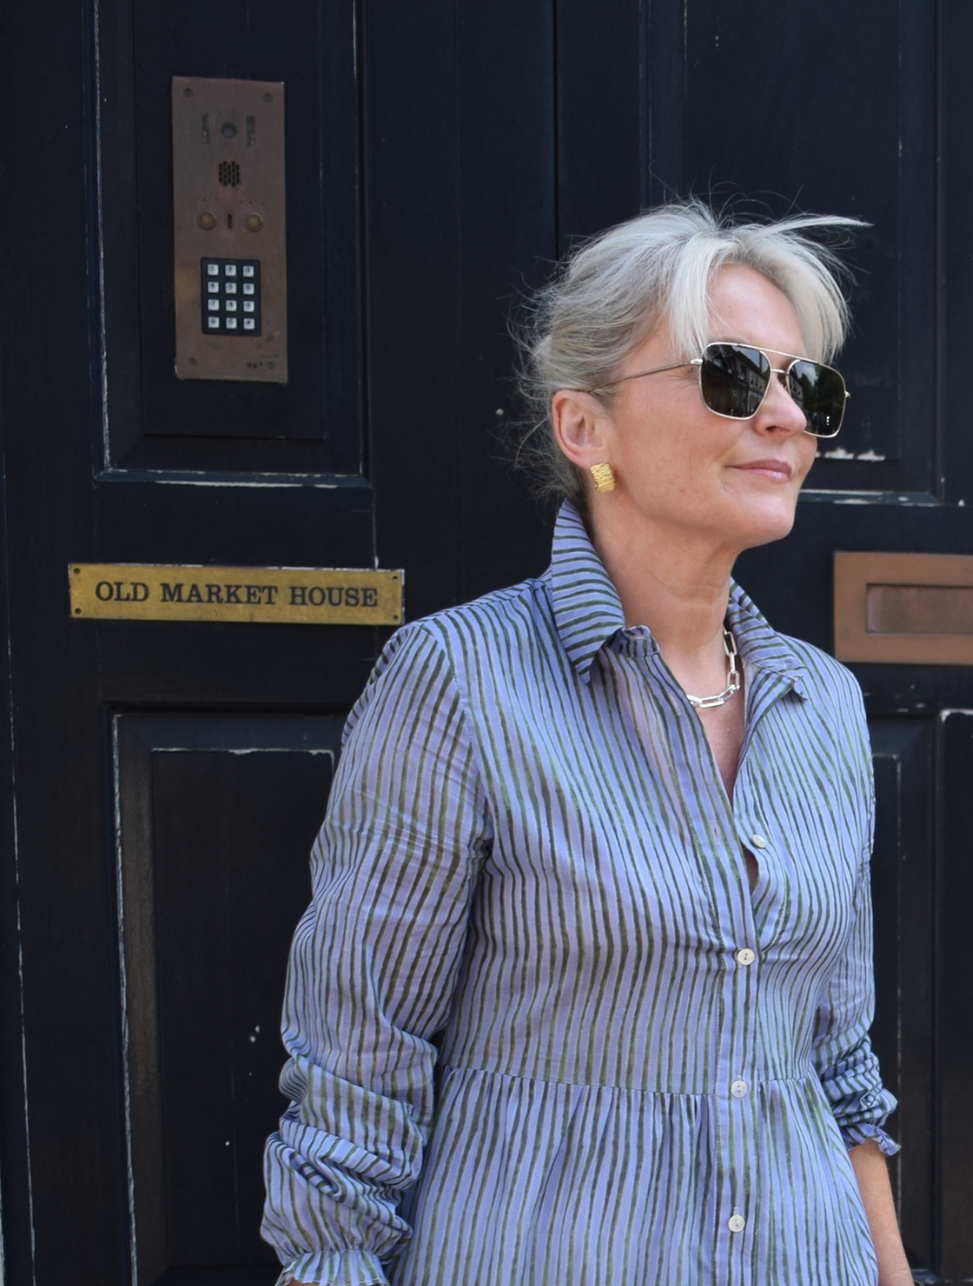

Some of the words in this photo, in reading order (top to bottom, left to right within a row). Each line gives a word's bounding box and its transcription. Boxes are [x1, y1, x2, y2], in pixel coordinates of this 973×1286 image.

[95, 581, 149, 602] OLD
[160, 582, 279, 606] MARKET
[288, 585, 378, 608] HOUSE
